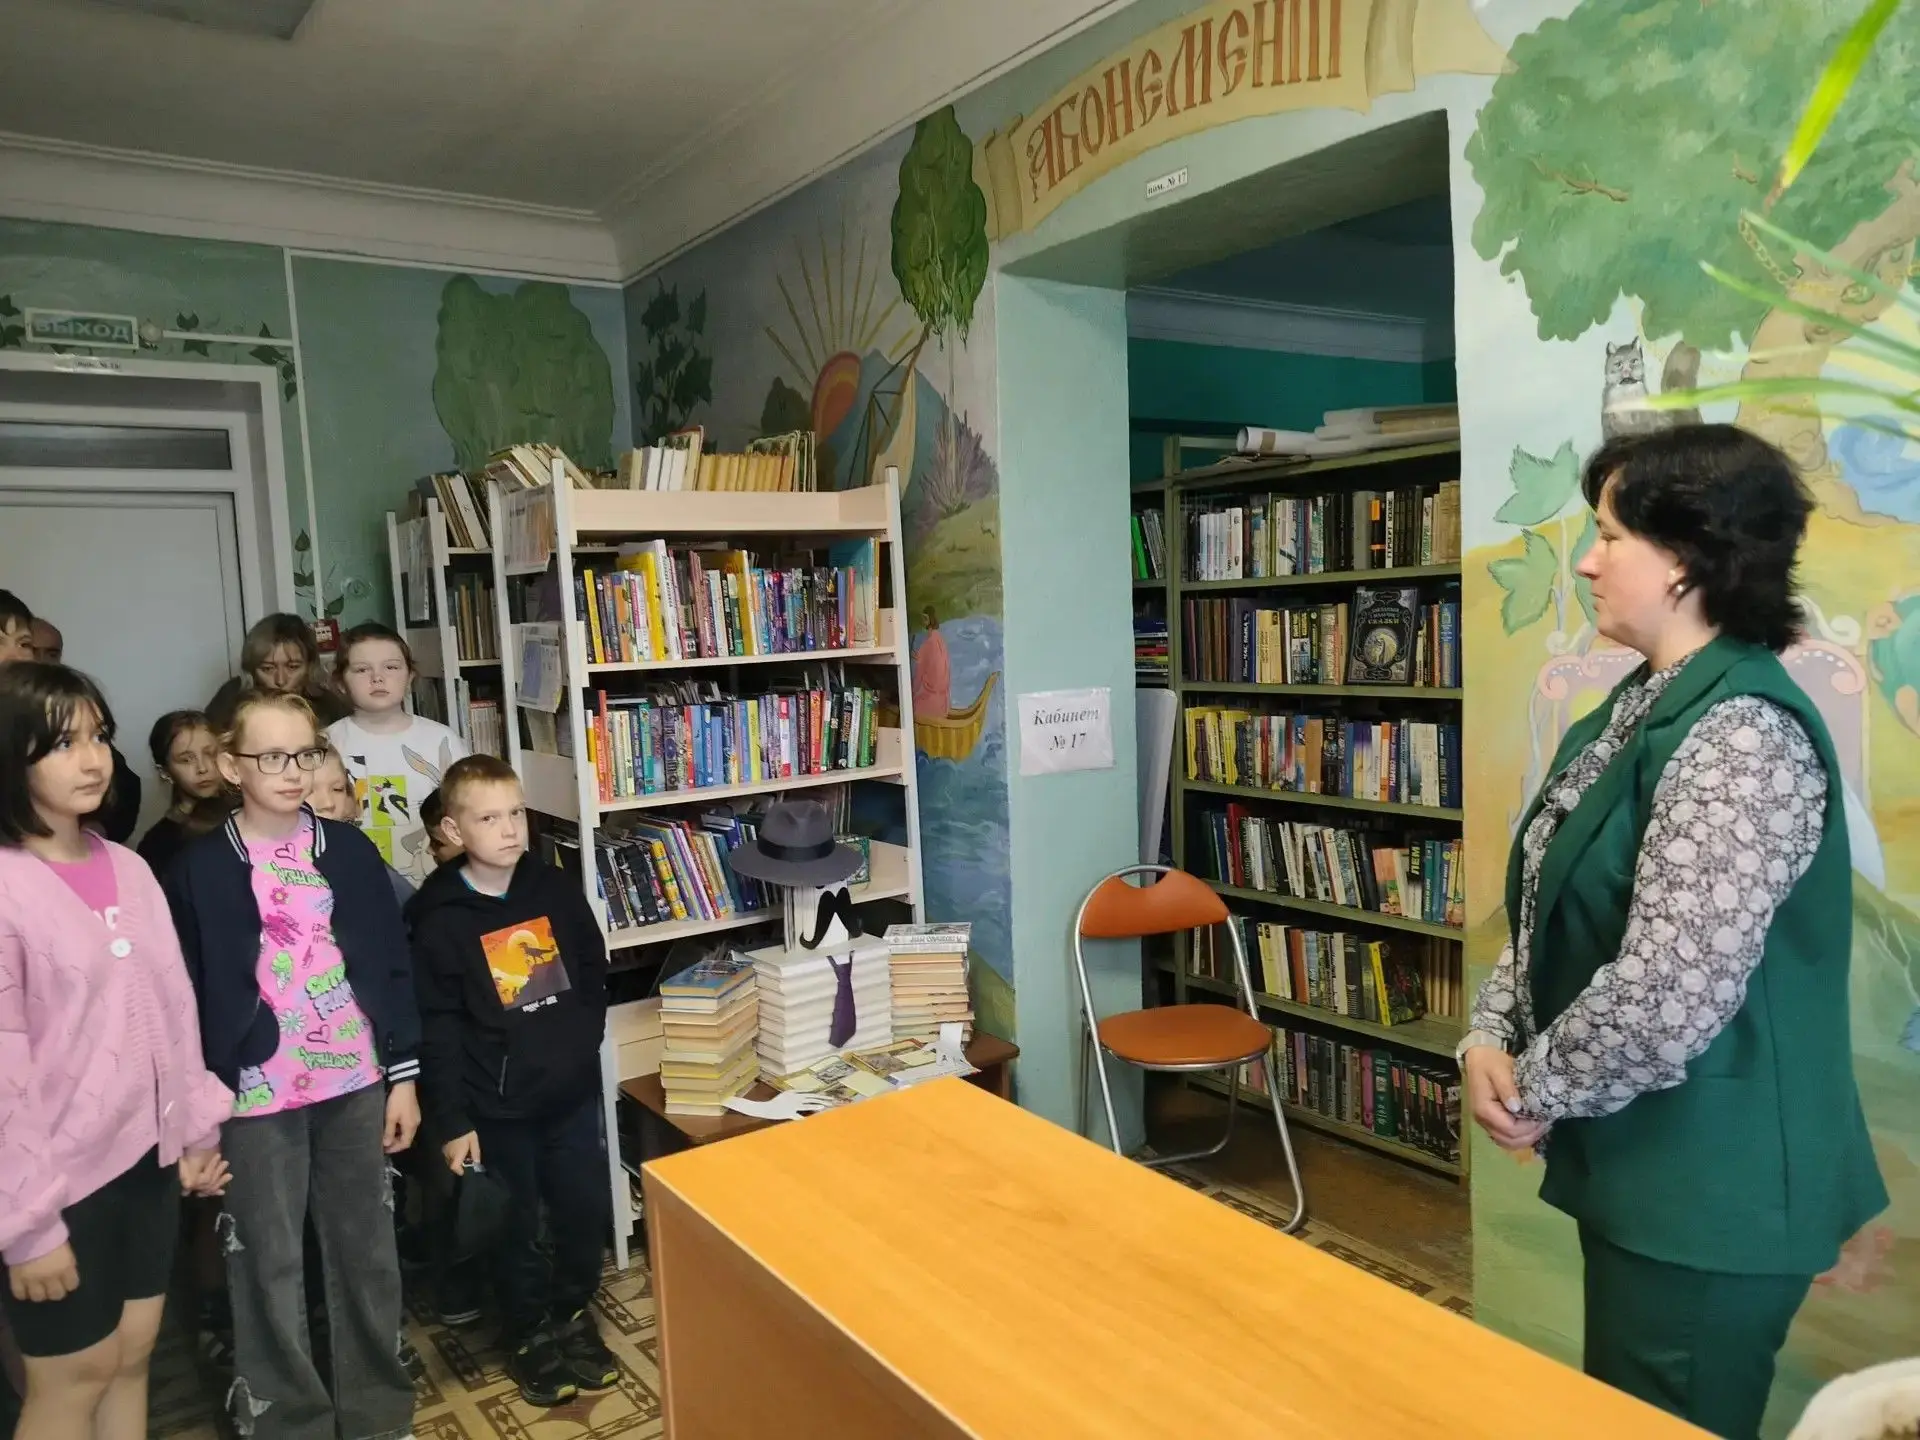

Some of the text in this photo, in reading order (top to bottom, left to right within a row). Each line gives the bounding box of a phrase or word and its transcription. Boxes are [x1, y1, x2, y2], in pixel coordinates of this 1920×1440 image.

[34, 317, 130, 343] ВЫХОД
[1033, 707, 1099, 726] Кабинет
[1049, 732, 1087, 751] № 17
[1410, 845, 1421, 876] ЛЕМ
